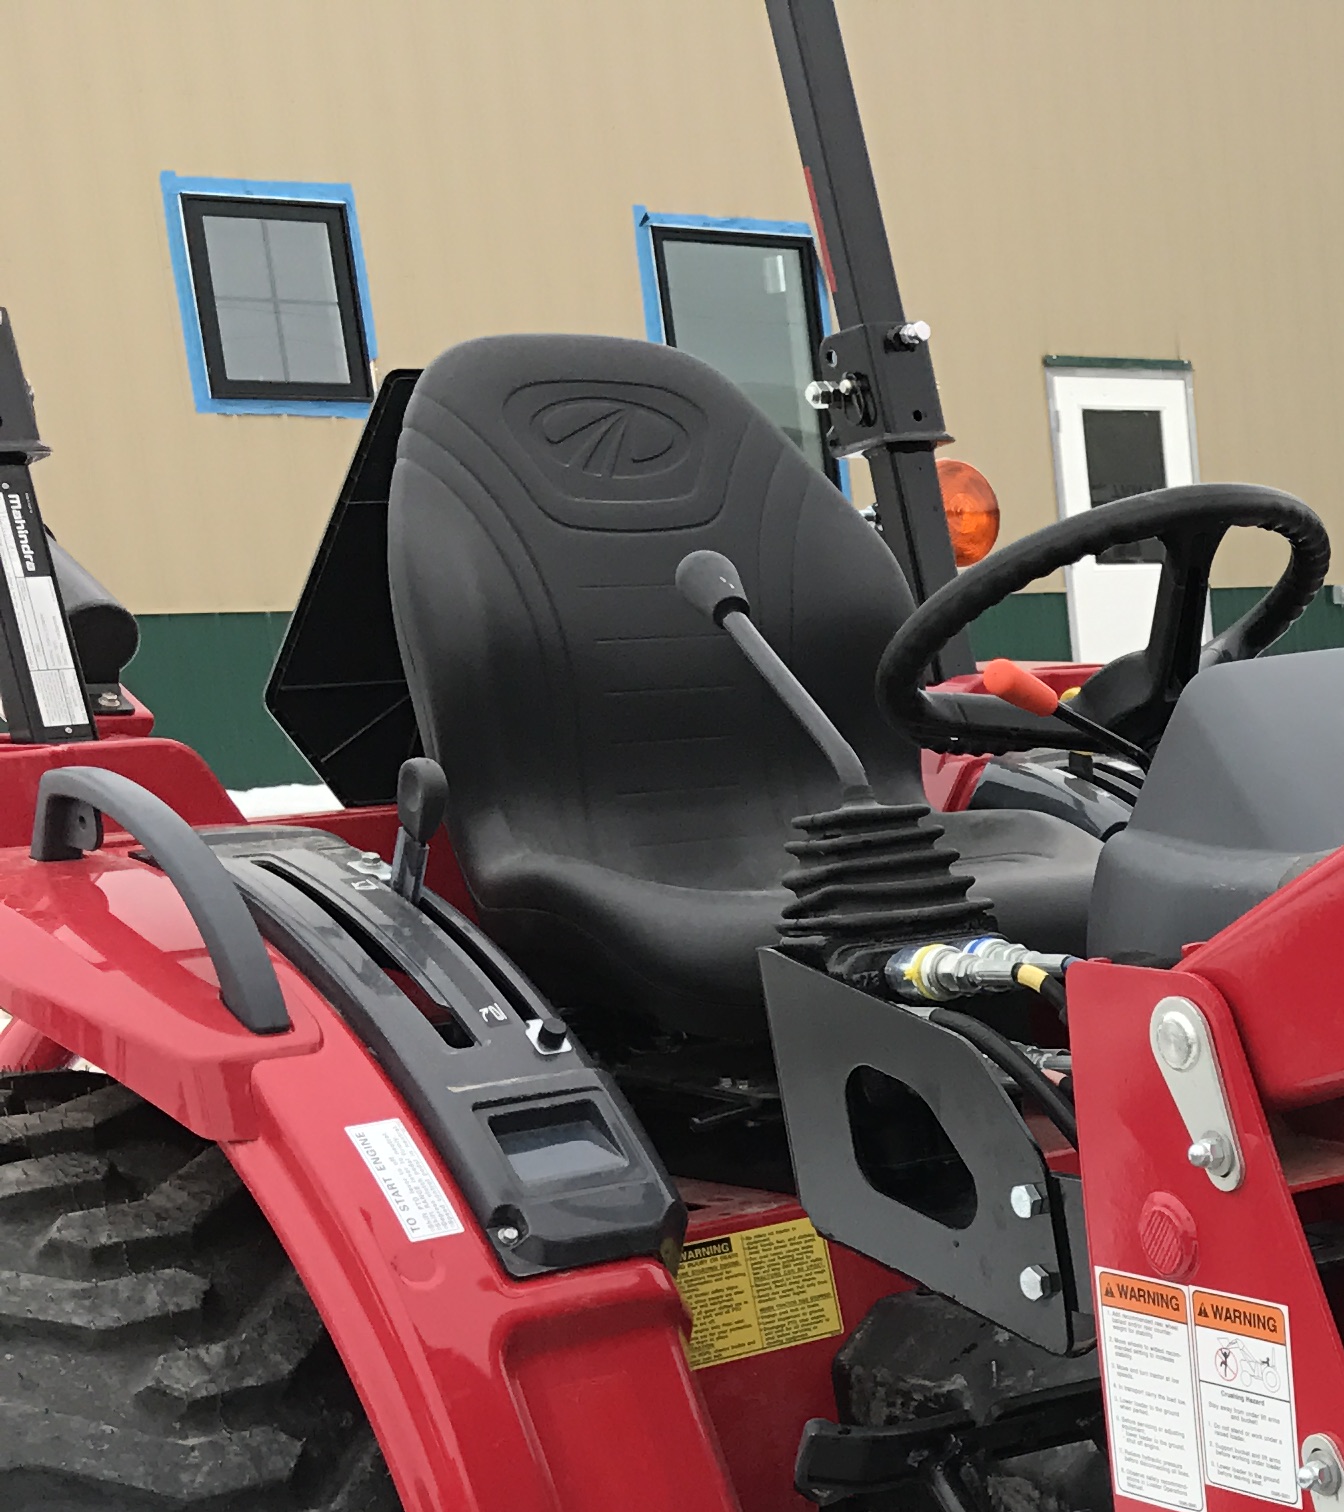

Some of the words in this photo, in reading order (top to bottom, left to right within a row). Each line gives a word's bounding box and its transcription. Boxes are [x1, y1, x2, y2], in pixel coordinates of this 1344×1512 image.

[8, 493, 37, 573] Mahindra
[355, 1131, 386, 1172] ENGINE
[382, 1176, 410, 1212] START
[406, 1217, 421, 1233] TO
[1115, 1283, 1180, 1312] WARNING
[1211, 1303, 1278, 1334] WARNING
[1220, 1389, 1244, 1402] Crushing
[1245, 1396, 1264, 1407] Hazard
